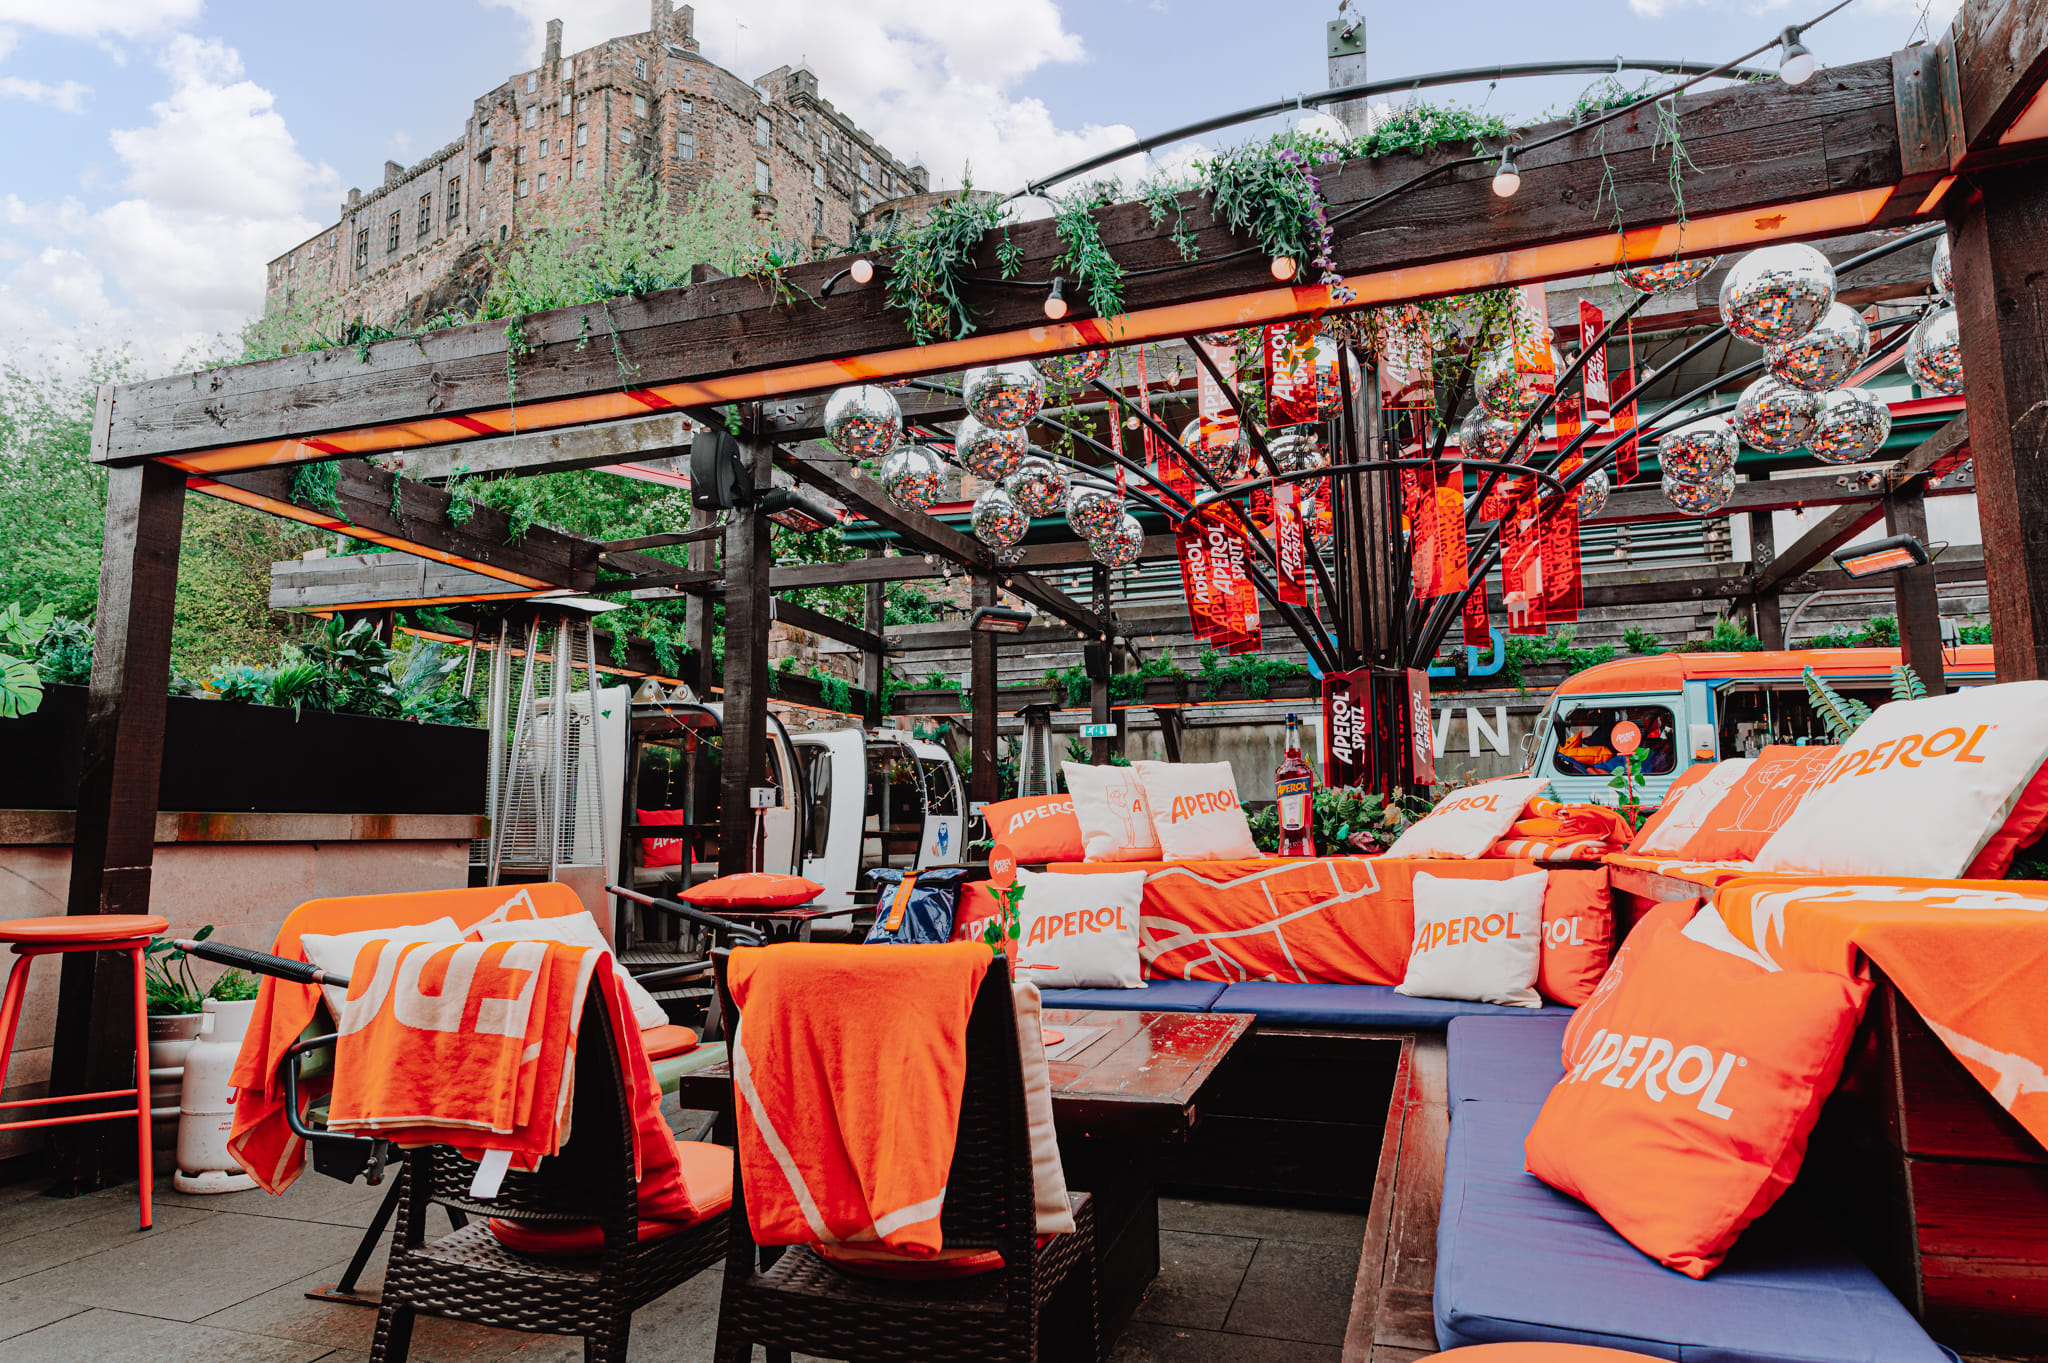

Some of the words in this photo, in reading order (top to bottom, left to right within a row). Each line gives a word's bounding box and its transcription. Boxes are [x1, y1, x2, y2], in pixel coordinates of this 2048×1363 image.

[1584, 321, 1600, 403] APEOL
[1208, 523, 1234, 595] APEROL
[1228, 537, 1246, 580] SPRITZ
[1280, 504, 1295, 582] APEROL
[1291, 521, 1302, 568] SPRITZ
[1332, 691, 1353, 765] APEROL
[1351, 706, 1366, 751] SPRITZ
[1413, 690, 1427, 764] APEROL
[1422, 706, 1431, 750] SPRITZ
[1772, 774, 1797, 789] A
[1808, 725, 1989, 799] APEROL
[1171, 789, 1240, 824] APEROL
[1277, 781, 1308, 797] APEROL
[1008, 801, 1076, 835] APERO
[1027, 906, 1128, 947] APEROL
[1414, 912, 1521, 956] APEROL
[1559, 1028, 1734, 1121] APEROL
